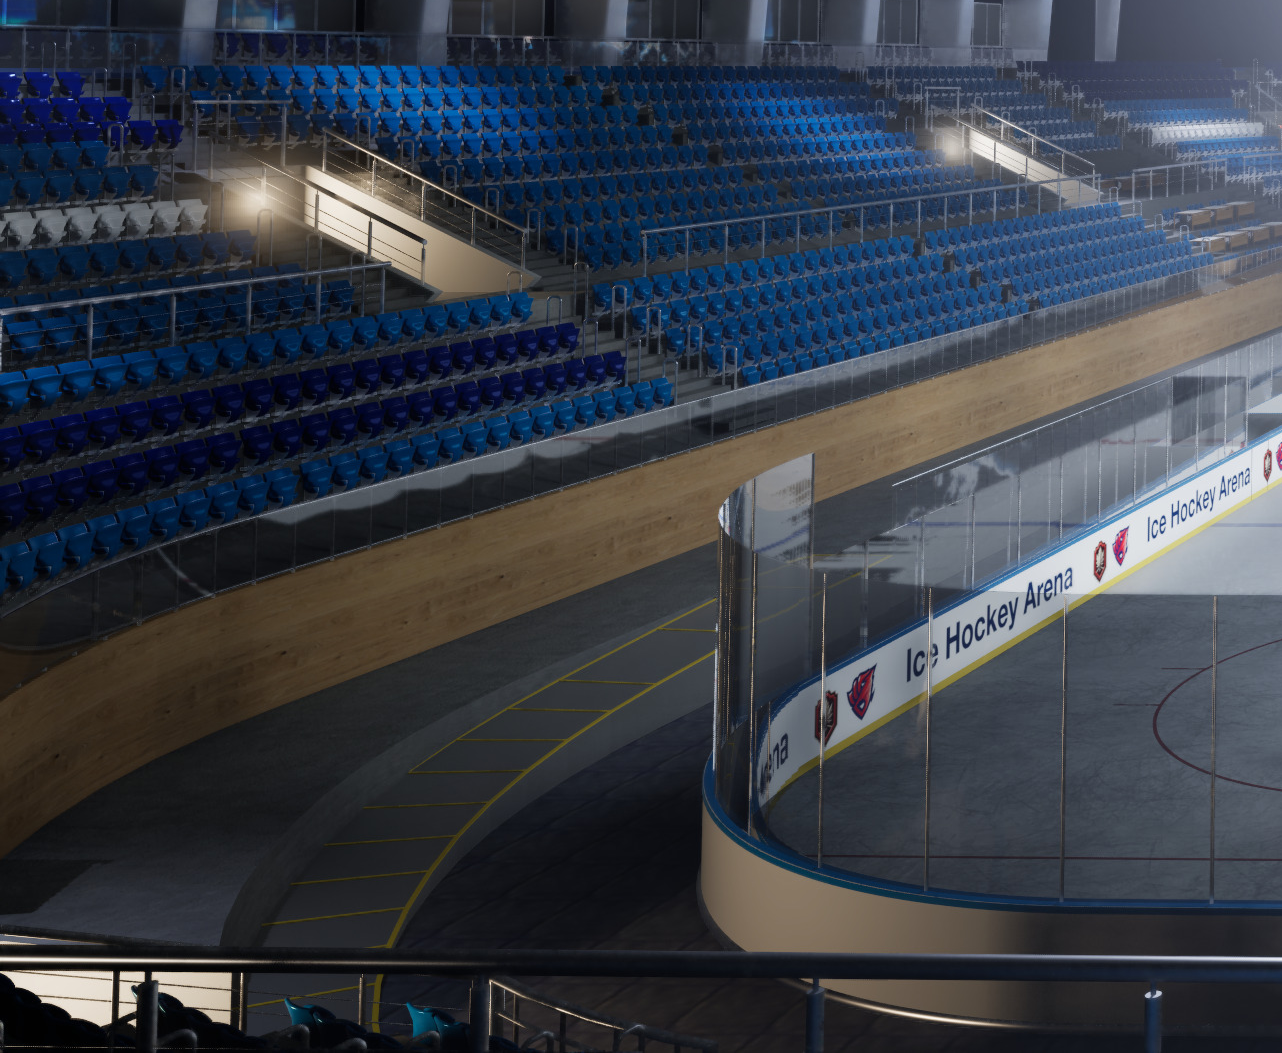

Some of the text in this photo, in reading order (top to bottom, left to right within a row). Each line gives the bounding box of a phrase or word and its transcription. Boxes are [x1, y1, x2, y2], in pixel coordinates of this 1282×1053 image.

[1147, 467, 1251, 542] Ice Hockey Arena
[906, 567, 1074, 683] Ice Hockey Arena
